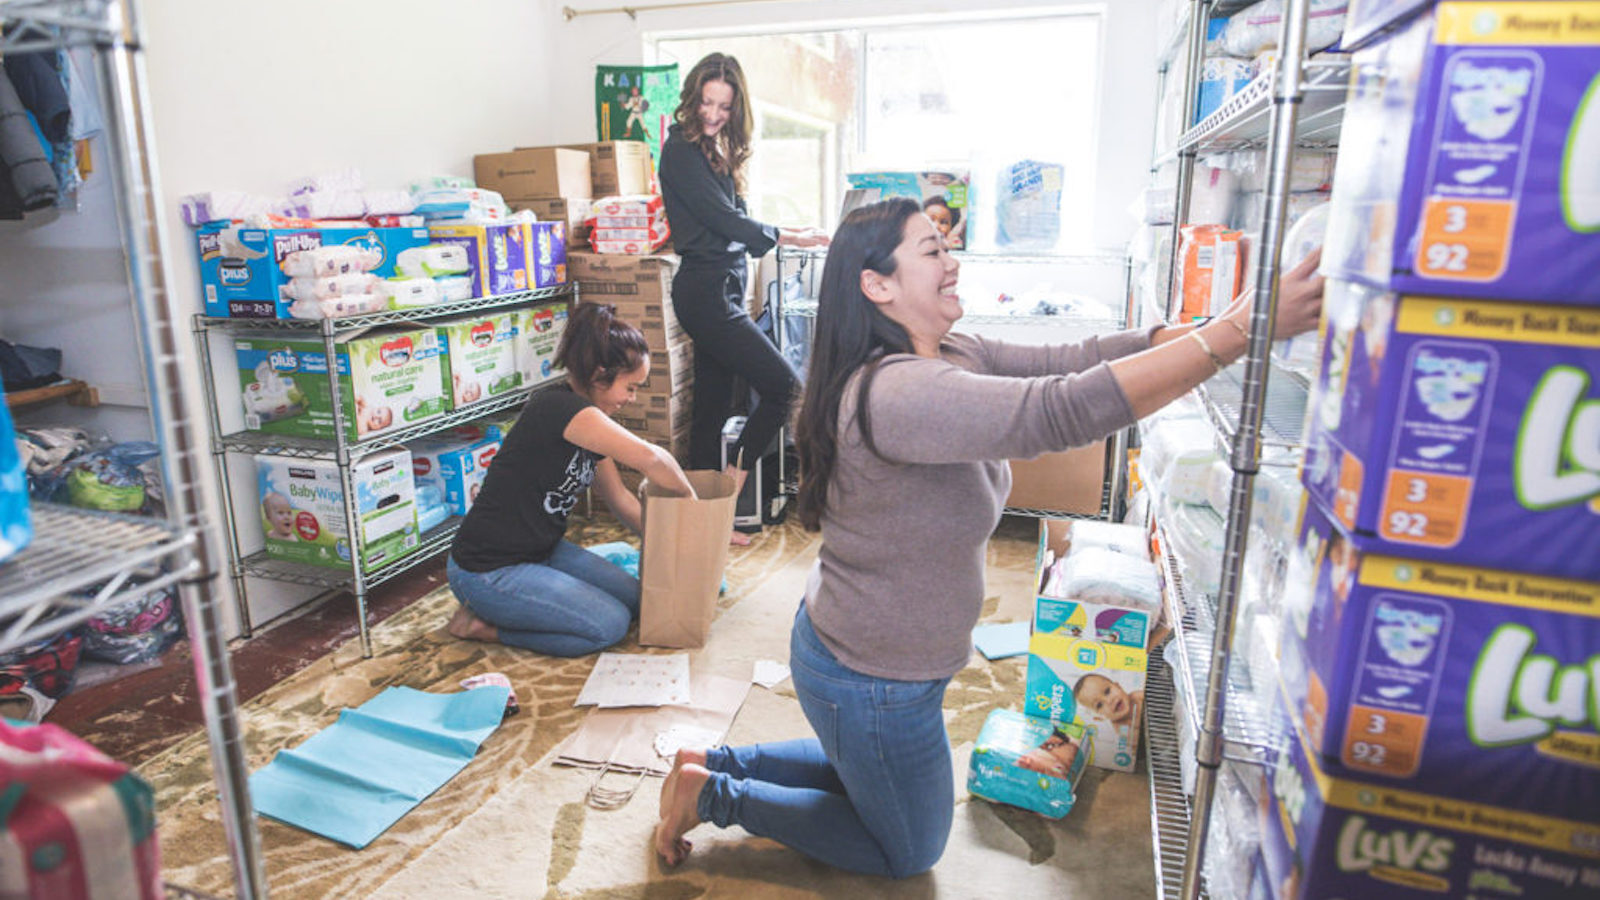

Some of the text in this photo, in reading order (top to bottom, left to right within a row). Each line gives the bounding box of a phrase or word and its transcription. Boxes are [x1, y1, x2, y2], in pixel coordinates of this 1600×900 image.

[1503, 15, 1561, 36] Money
[1443, 205, 1467, 233] 3
[1426, 242, 1469, 272] 92
[1463, 309, 1515, 333] Money
[1522, 313, 1559, 333] Back
[270, 352, 298, 370] plus
[371, 367, 404, 382] natural
[405, 364, 424, 375] care
[1407, 478, 1428, 502] 3
[1390, 510, 1428, 538] 92
[1421, 568, 1593, 605] Money Back Guarantee
[1368, 714, 1386, 734] 3
[1353, 741, 1386, 766] 92
[1383, 794, 1428, 818] Money
